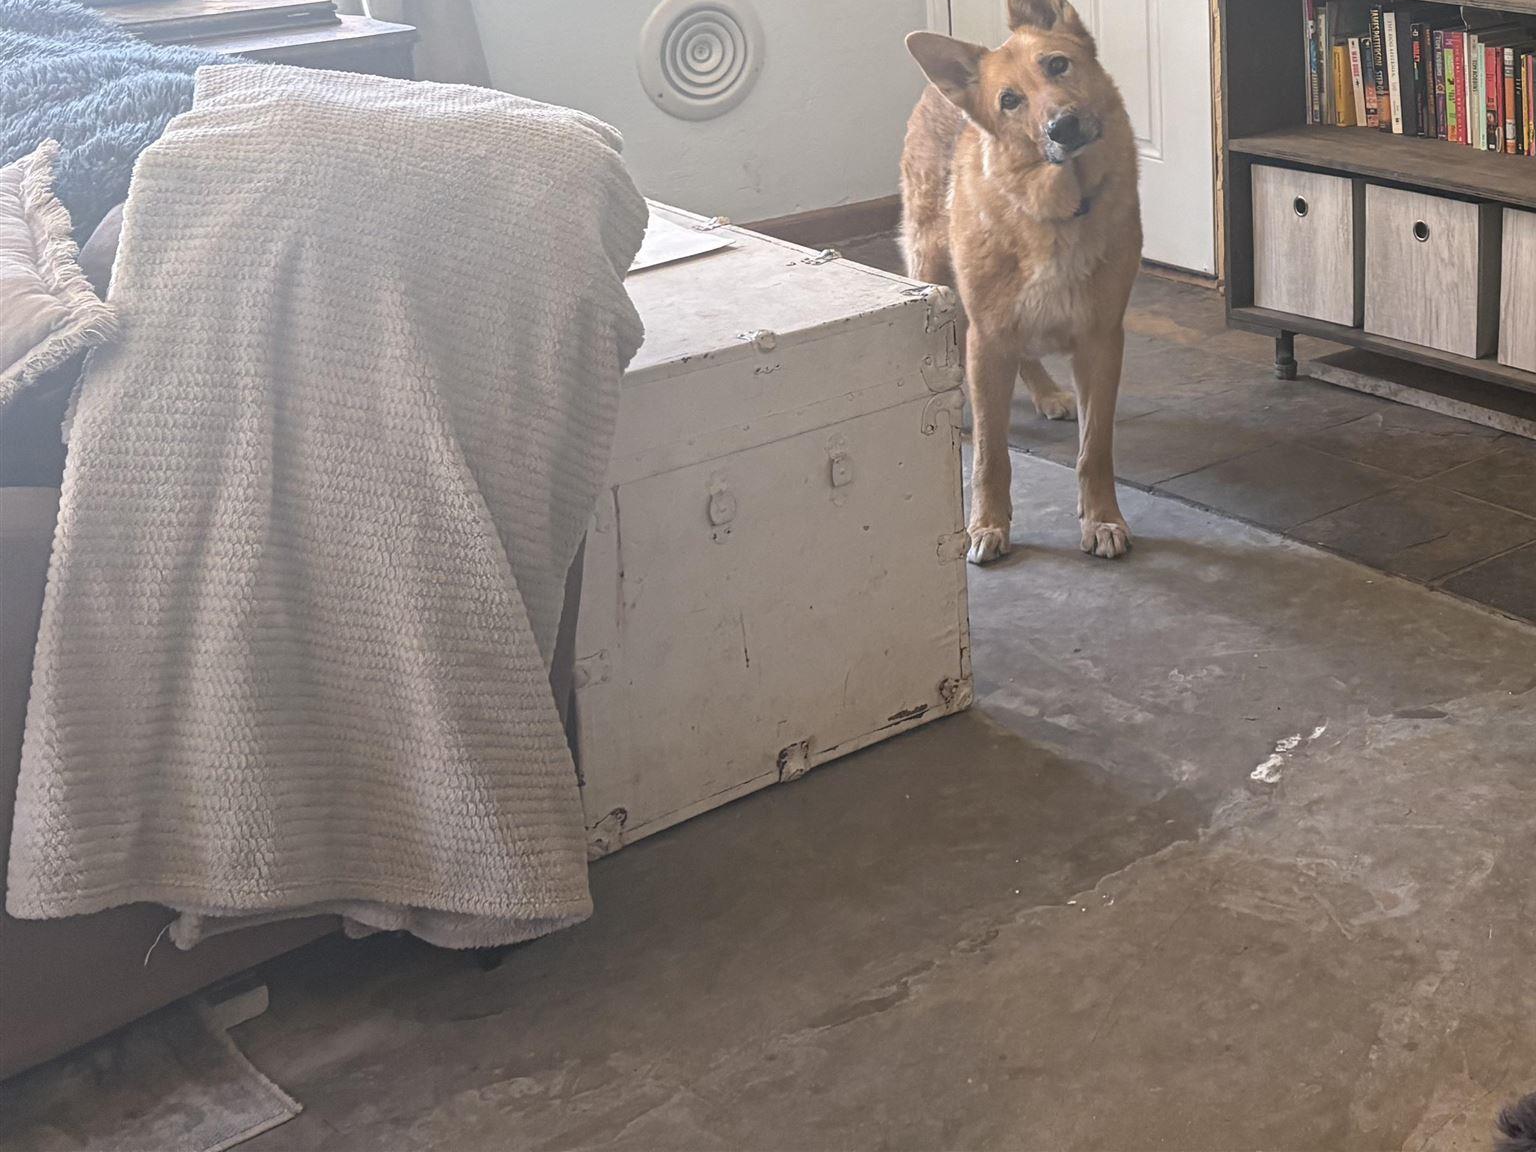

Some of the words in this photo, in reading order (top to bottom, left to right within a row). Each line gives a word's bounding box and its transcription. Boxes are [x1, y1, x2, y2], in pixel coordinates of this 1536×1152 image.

[1370, 9, 1379, 31] JAMES
[1372, 30, 1382, 66] PATTERSON
[1375, 70, 1384, 84] STEP
